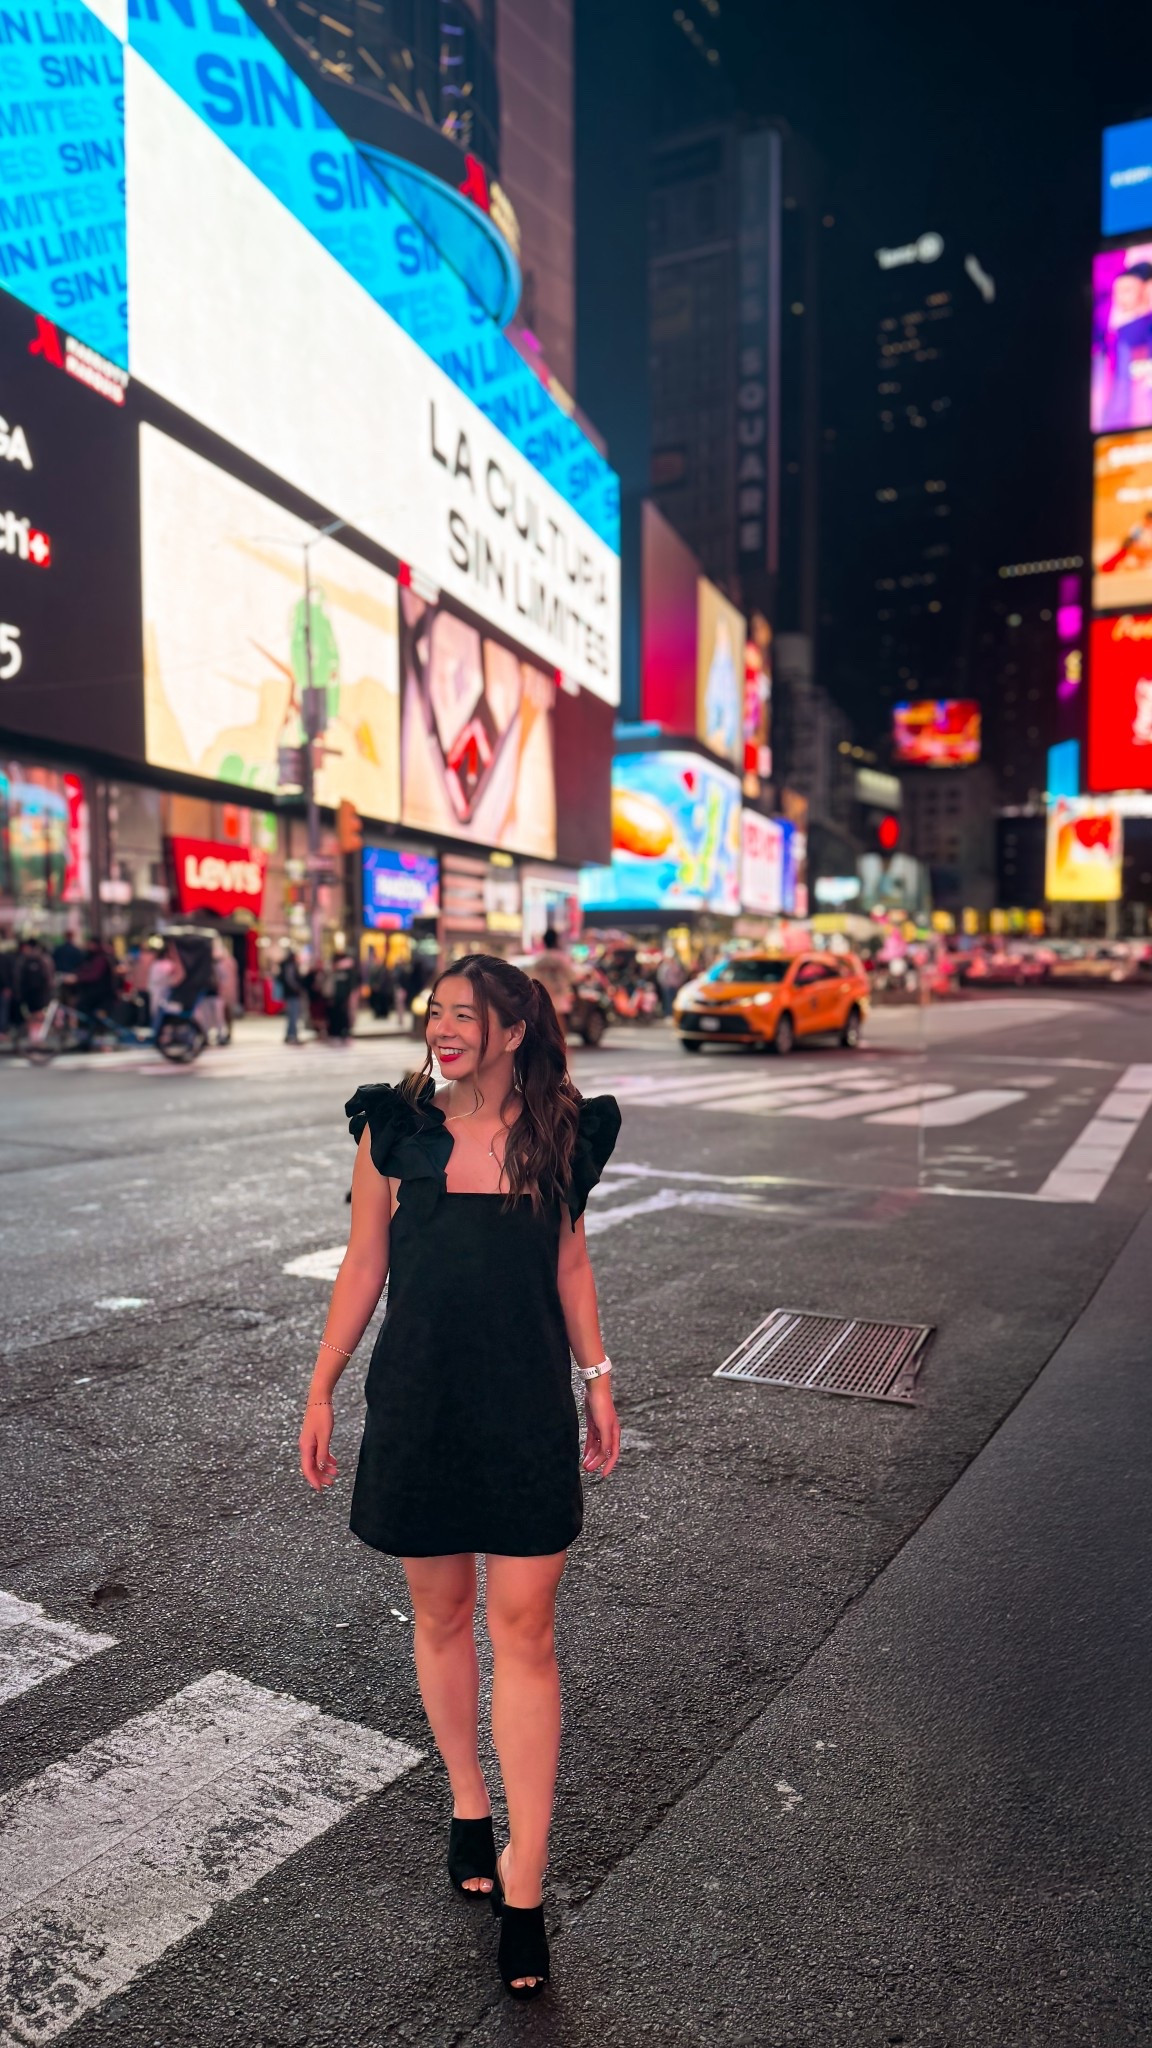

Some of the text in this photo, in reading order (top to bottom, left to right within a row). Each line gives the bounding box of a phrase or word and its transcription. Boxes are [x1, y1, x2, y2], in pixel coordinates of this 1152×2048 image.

[39, 54, 101, 89] SIN
[58, 138, 117, 176] SIN
[51, 266, 110, 309] SIN
[737, 345, 766, 552] SQUARE
[431, 400, 609, 606] LA CULTURA
[448, 508, 610, 678] SIN LIMITES
